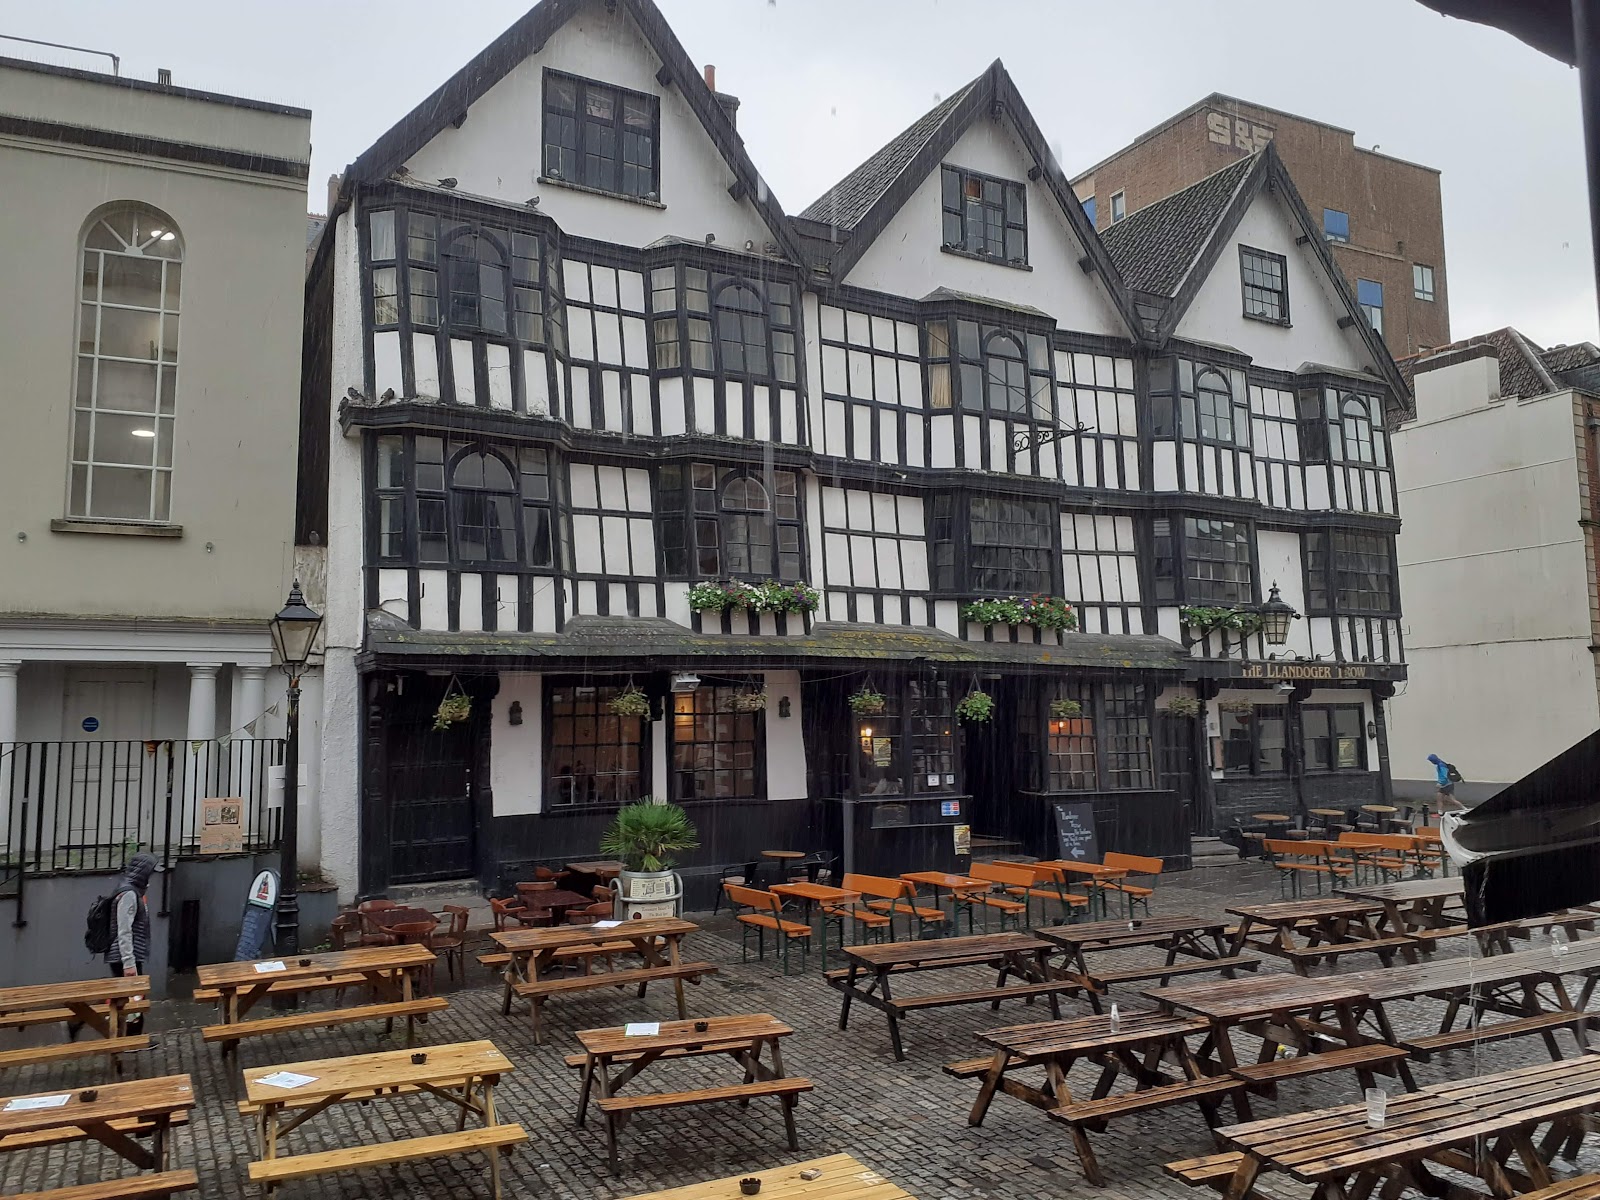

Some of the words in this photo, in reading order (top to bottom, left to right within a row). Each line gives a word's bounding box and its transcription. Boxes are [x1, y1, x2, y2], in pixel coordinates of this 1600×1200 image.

[1241, 664, 1263, 678] THE
[1267, 663, 1332, 678] LLANDOGER
[1337, 665, 1366, 679] TROW
